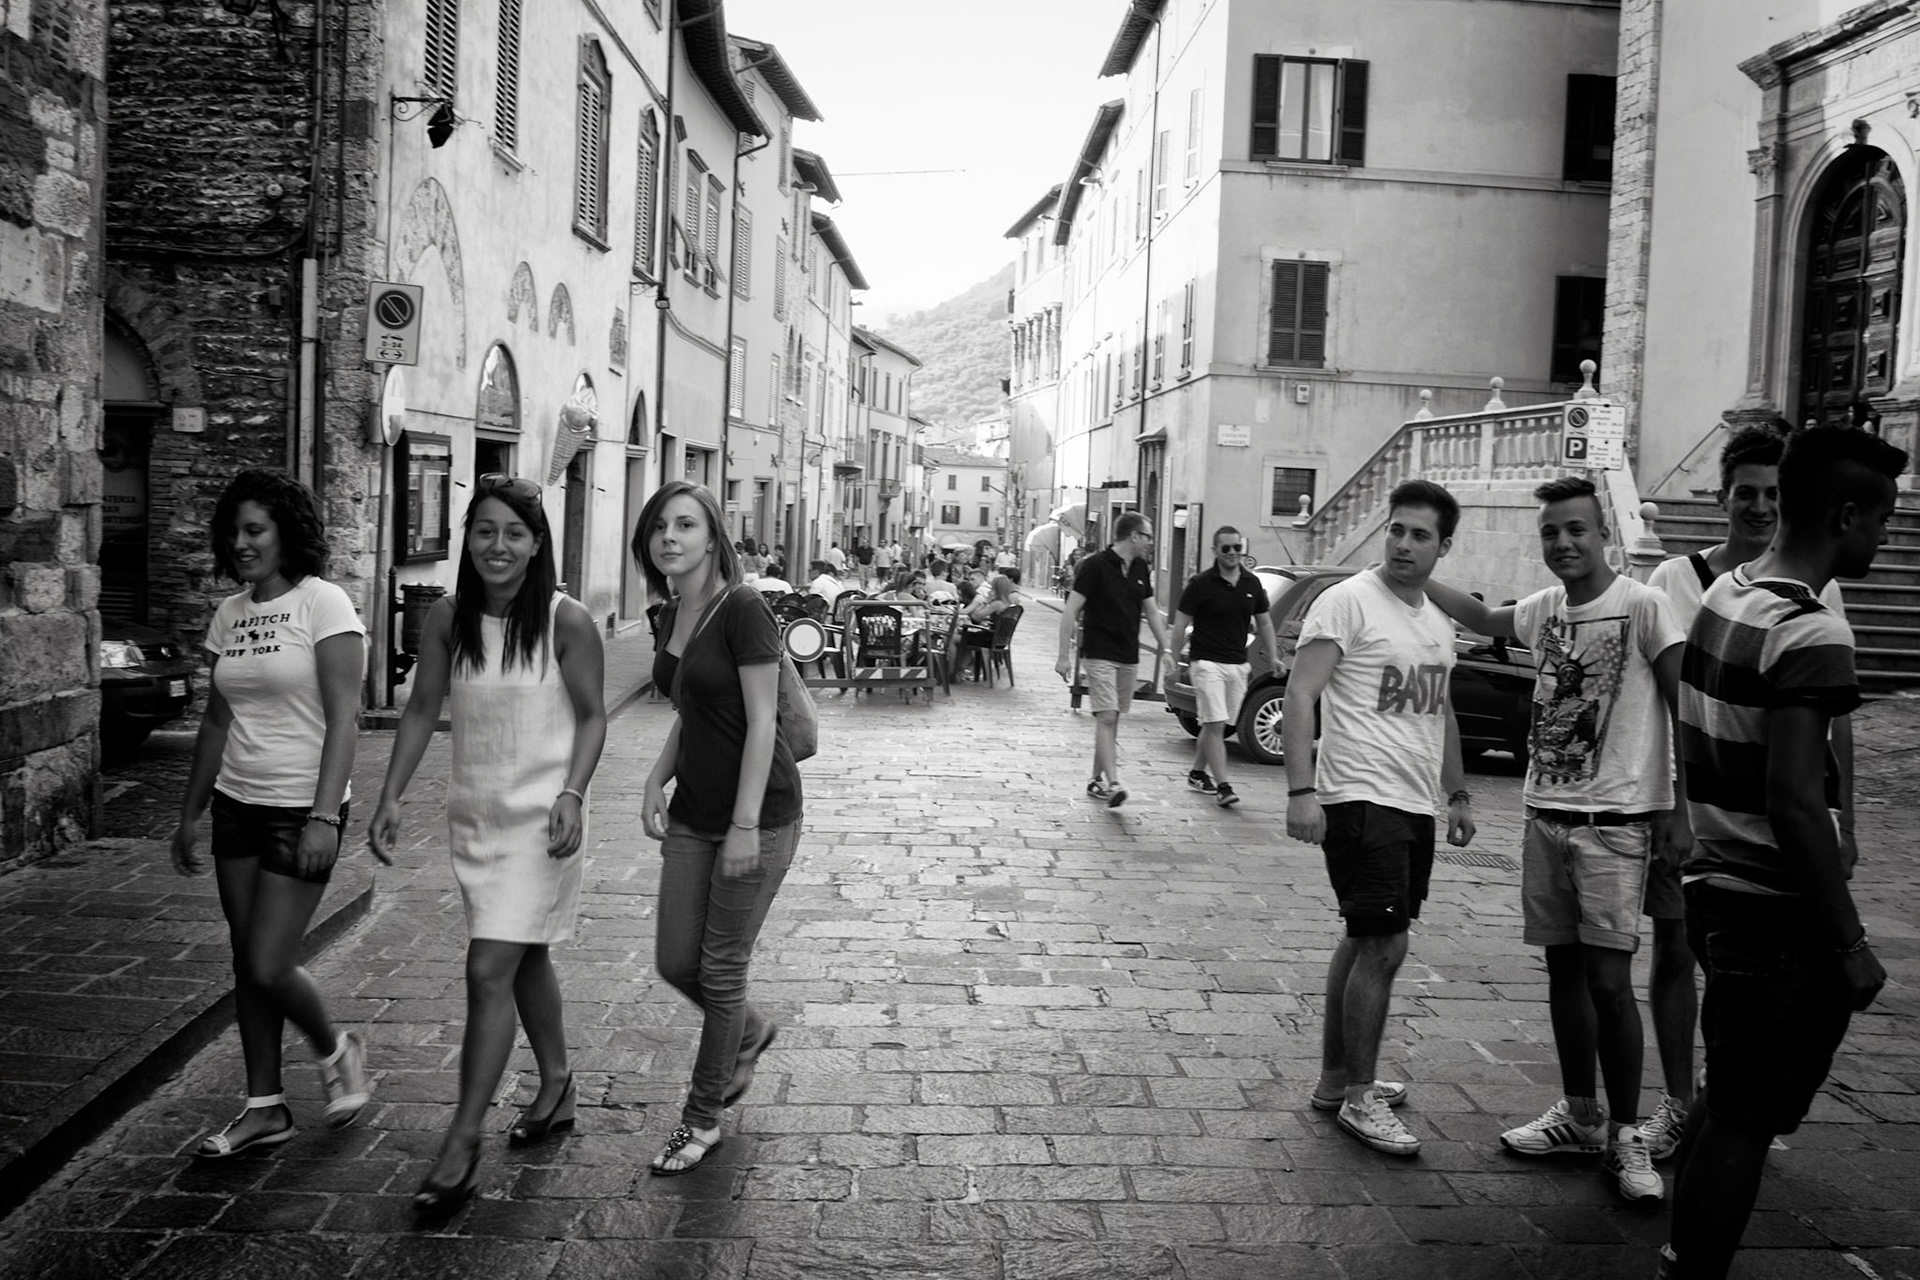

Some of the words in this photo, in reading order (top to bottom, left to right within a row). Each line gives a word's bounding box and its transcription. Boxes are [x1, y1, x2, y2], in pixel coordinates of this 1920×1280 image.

[1569, 440, 1583, 457] P
[263, 630, 276, 640] 92
[252, 645, 281, 656] YORK
[1377, 664, 1446, 715] BASTA
